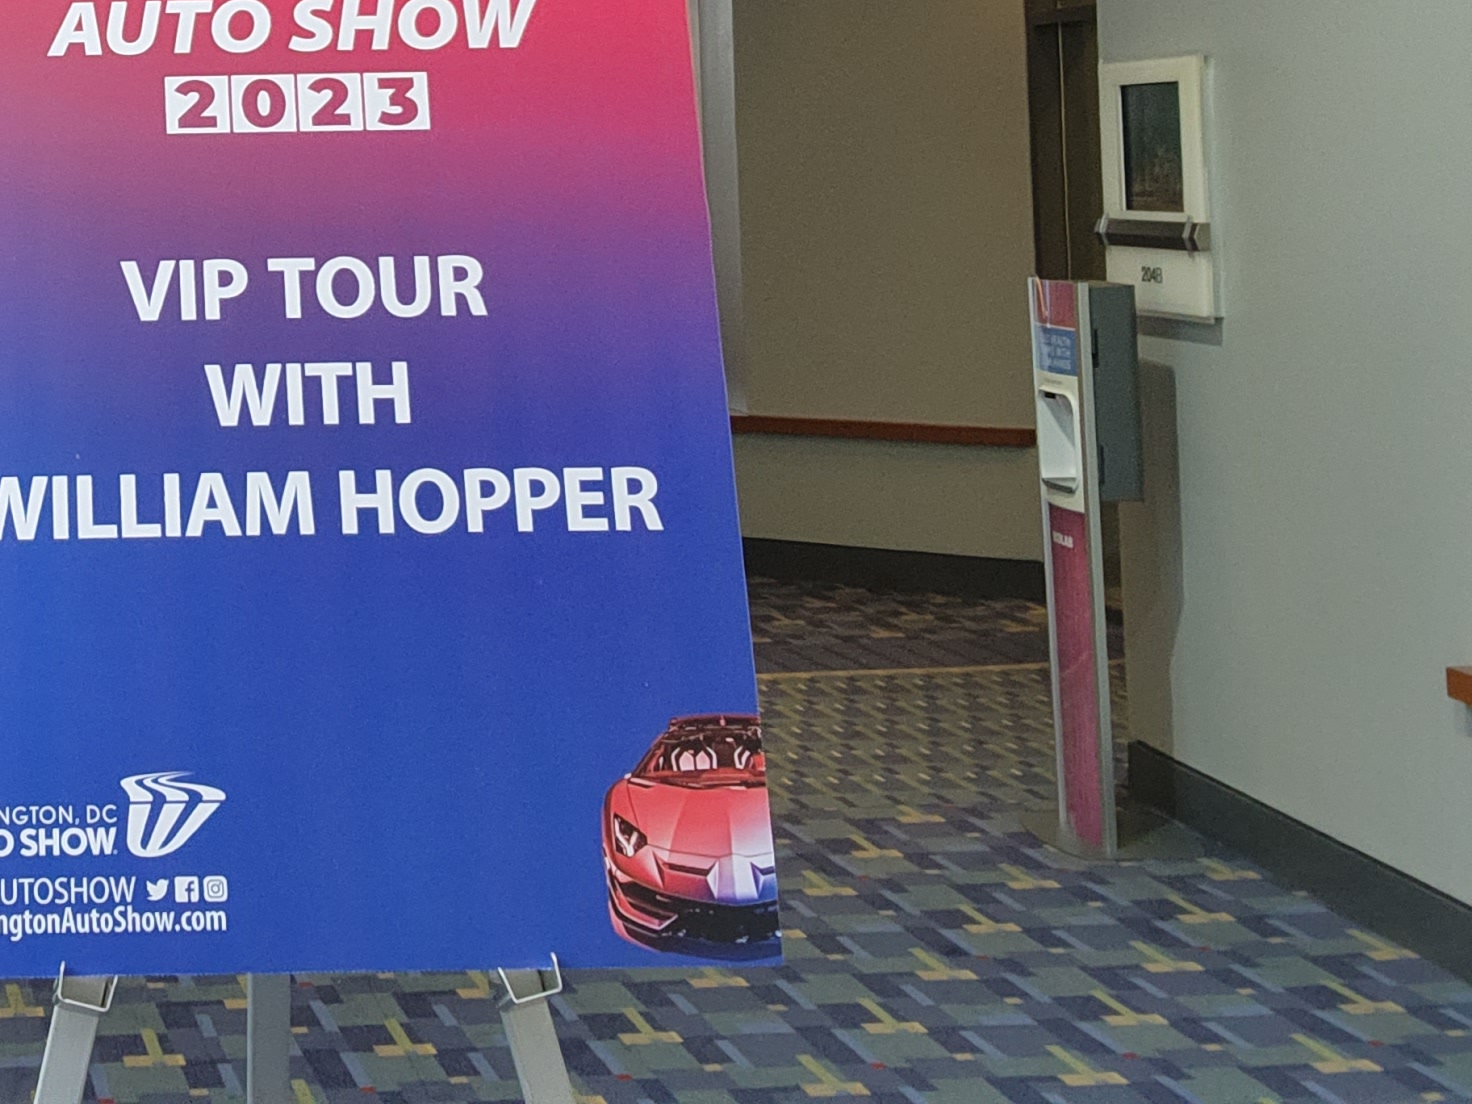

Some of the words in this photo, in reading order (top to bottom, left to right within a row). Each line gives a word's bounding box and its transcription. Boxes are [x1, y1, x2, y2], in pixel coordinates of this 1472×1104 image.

[169, 74, 425, 132] 2023
[120, 258, 249, 321] VIP
[267, 254, 488, 319] TOUR
[203, 361, 411, 427] WITH
[338, 465, 664, 535] HOPPER
[19, 826, 118, 857] SHOW
[86, 804, 118, 825] DC
